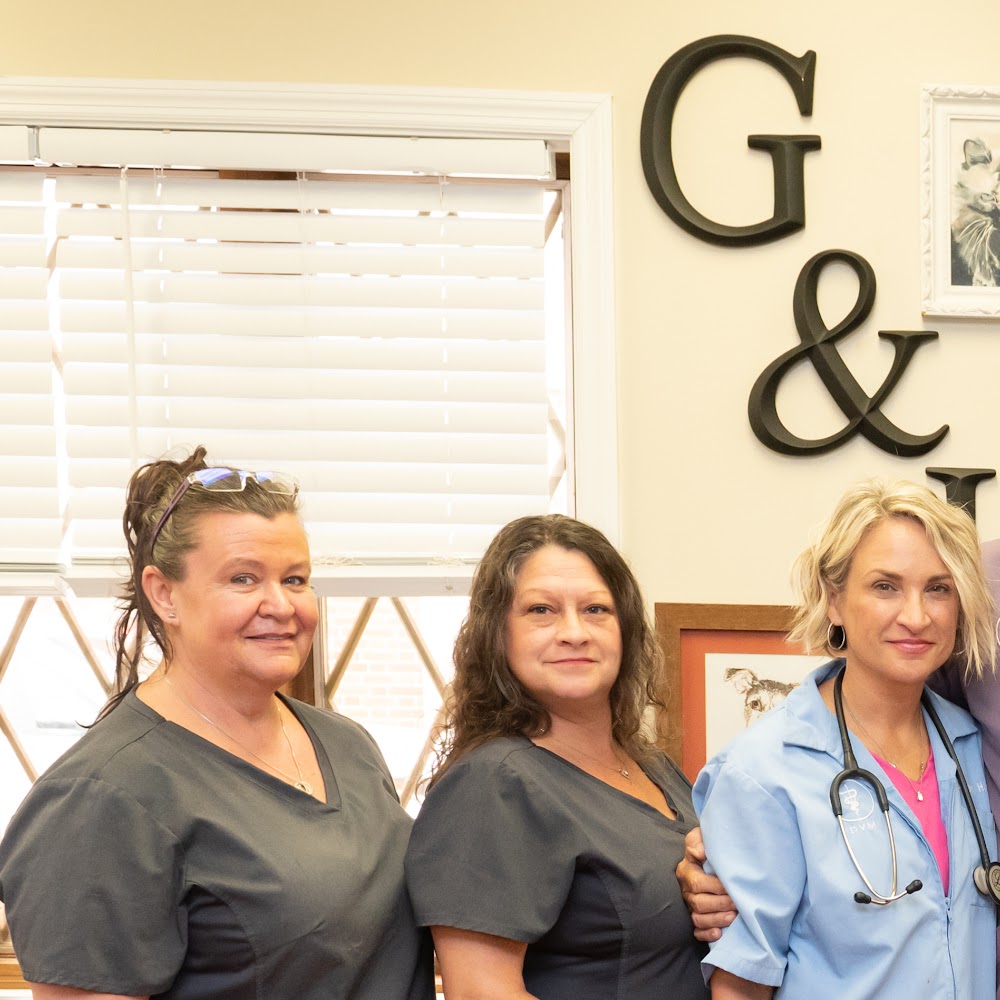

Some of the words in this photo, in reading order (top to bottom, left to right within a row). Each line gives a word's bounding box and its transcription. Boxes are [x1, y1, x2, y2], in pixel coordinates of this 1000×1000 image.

[640, 34, 821, 247] G
[748, 249, 949, 457] &
[849, 821, 877, 834] DVM
